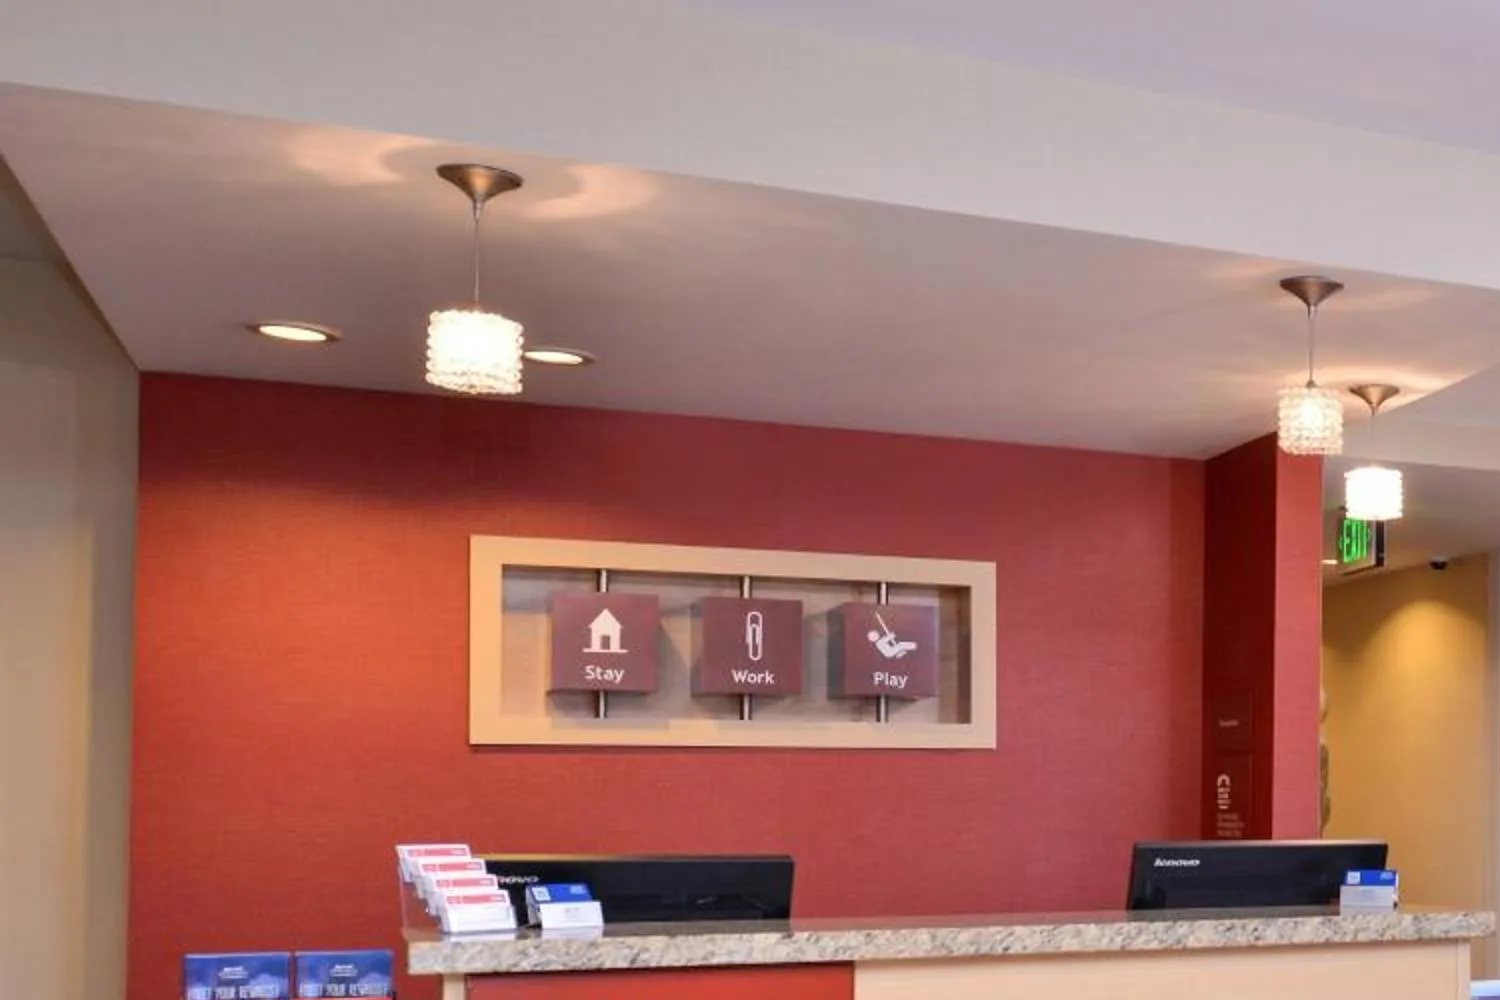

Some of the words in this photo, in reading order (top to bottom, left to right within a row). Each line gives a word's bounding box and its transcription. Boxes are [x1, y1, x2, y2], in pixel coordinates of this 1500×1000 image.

[585, 665, 625, 683] Stay
[732, 669, 775, 685] Work
[874, 671, 908, 688] Play
